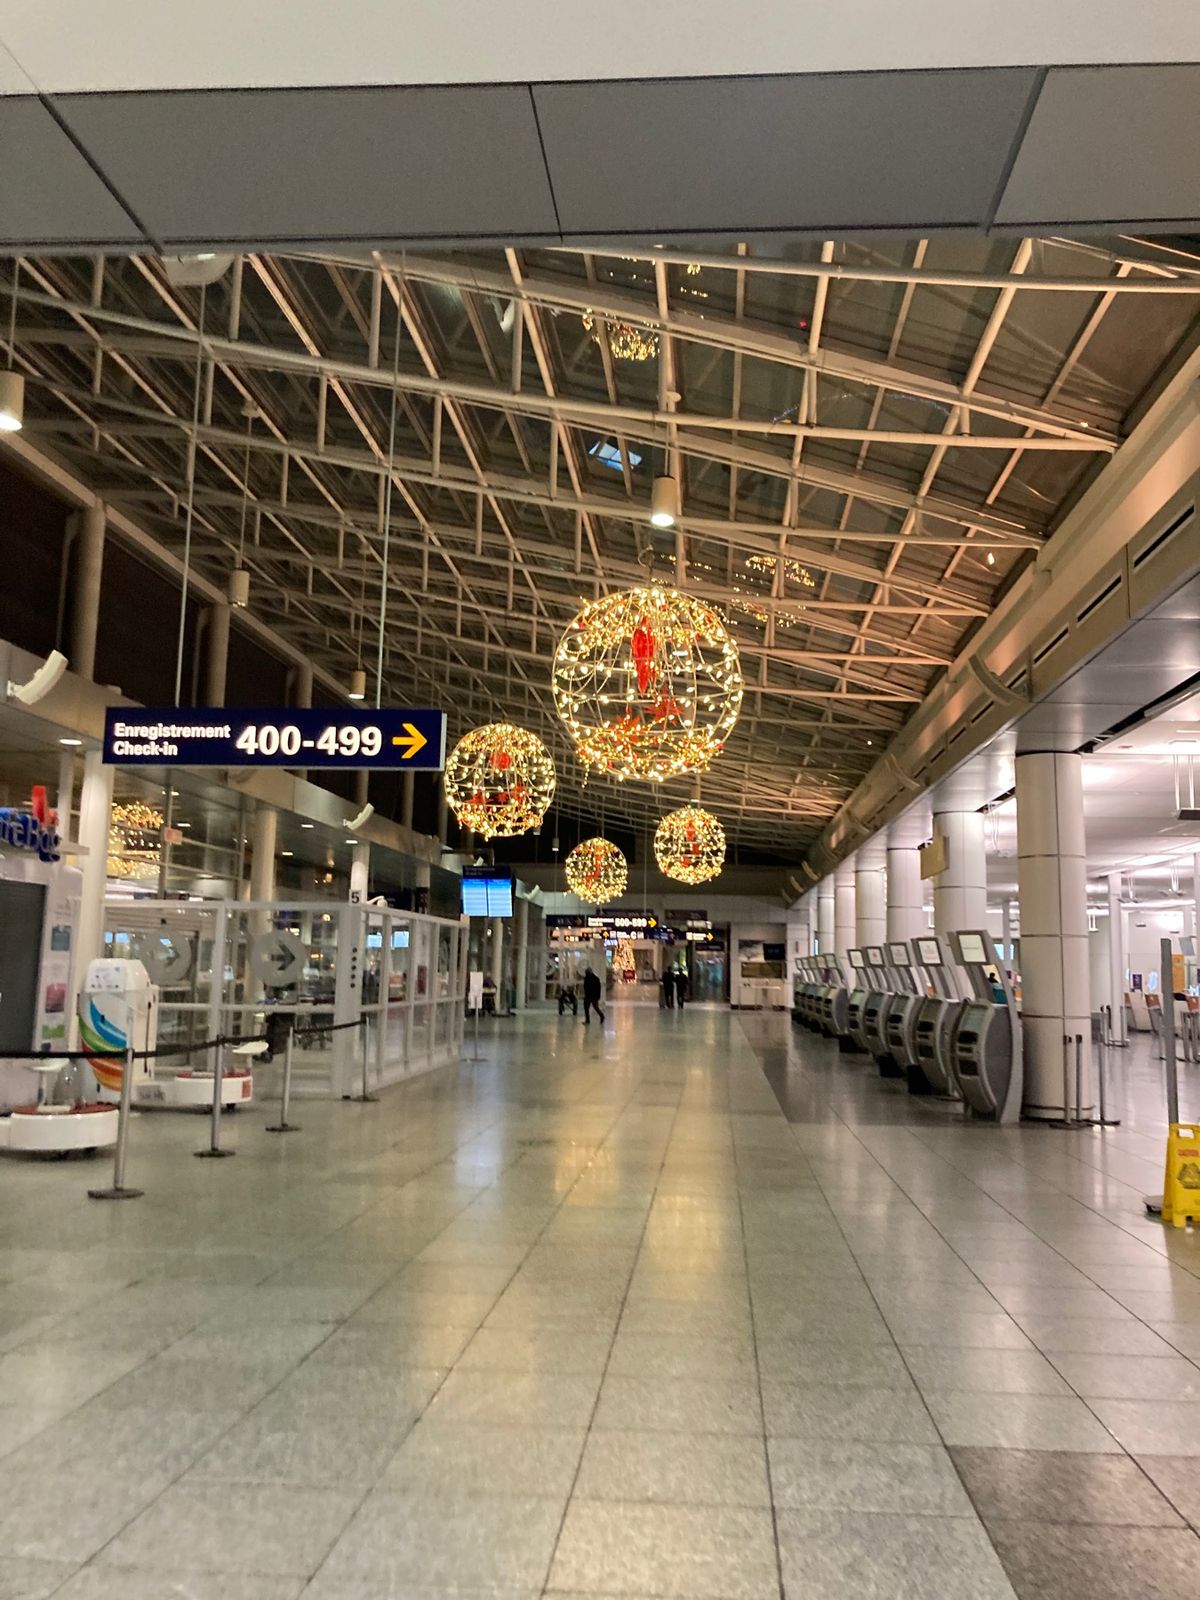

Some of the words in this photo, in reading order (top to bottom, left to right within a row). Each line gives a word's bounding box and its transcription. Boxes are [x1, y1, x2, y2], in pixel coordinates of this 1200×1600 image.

[114, 722, 231, 740] Enregistrement
[113, 741, 178, 756] Check-in
[235, 725, 382, 756] 400-499
[351, 891, 360, 904] 5
